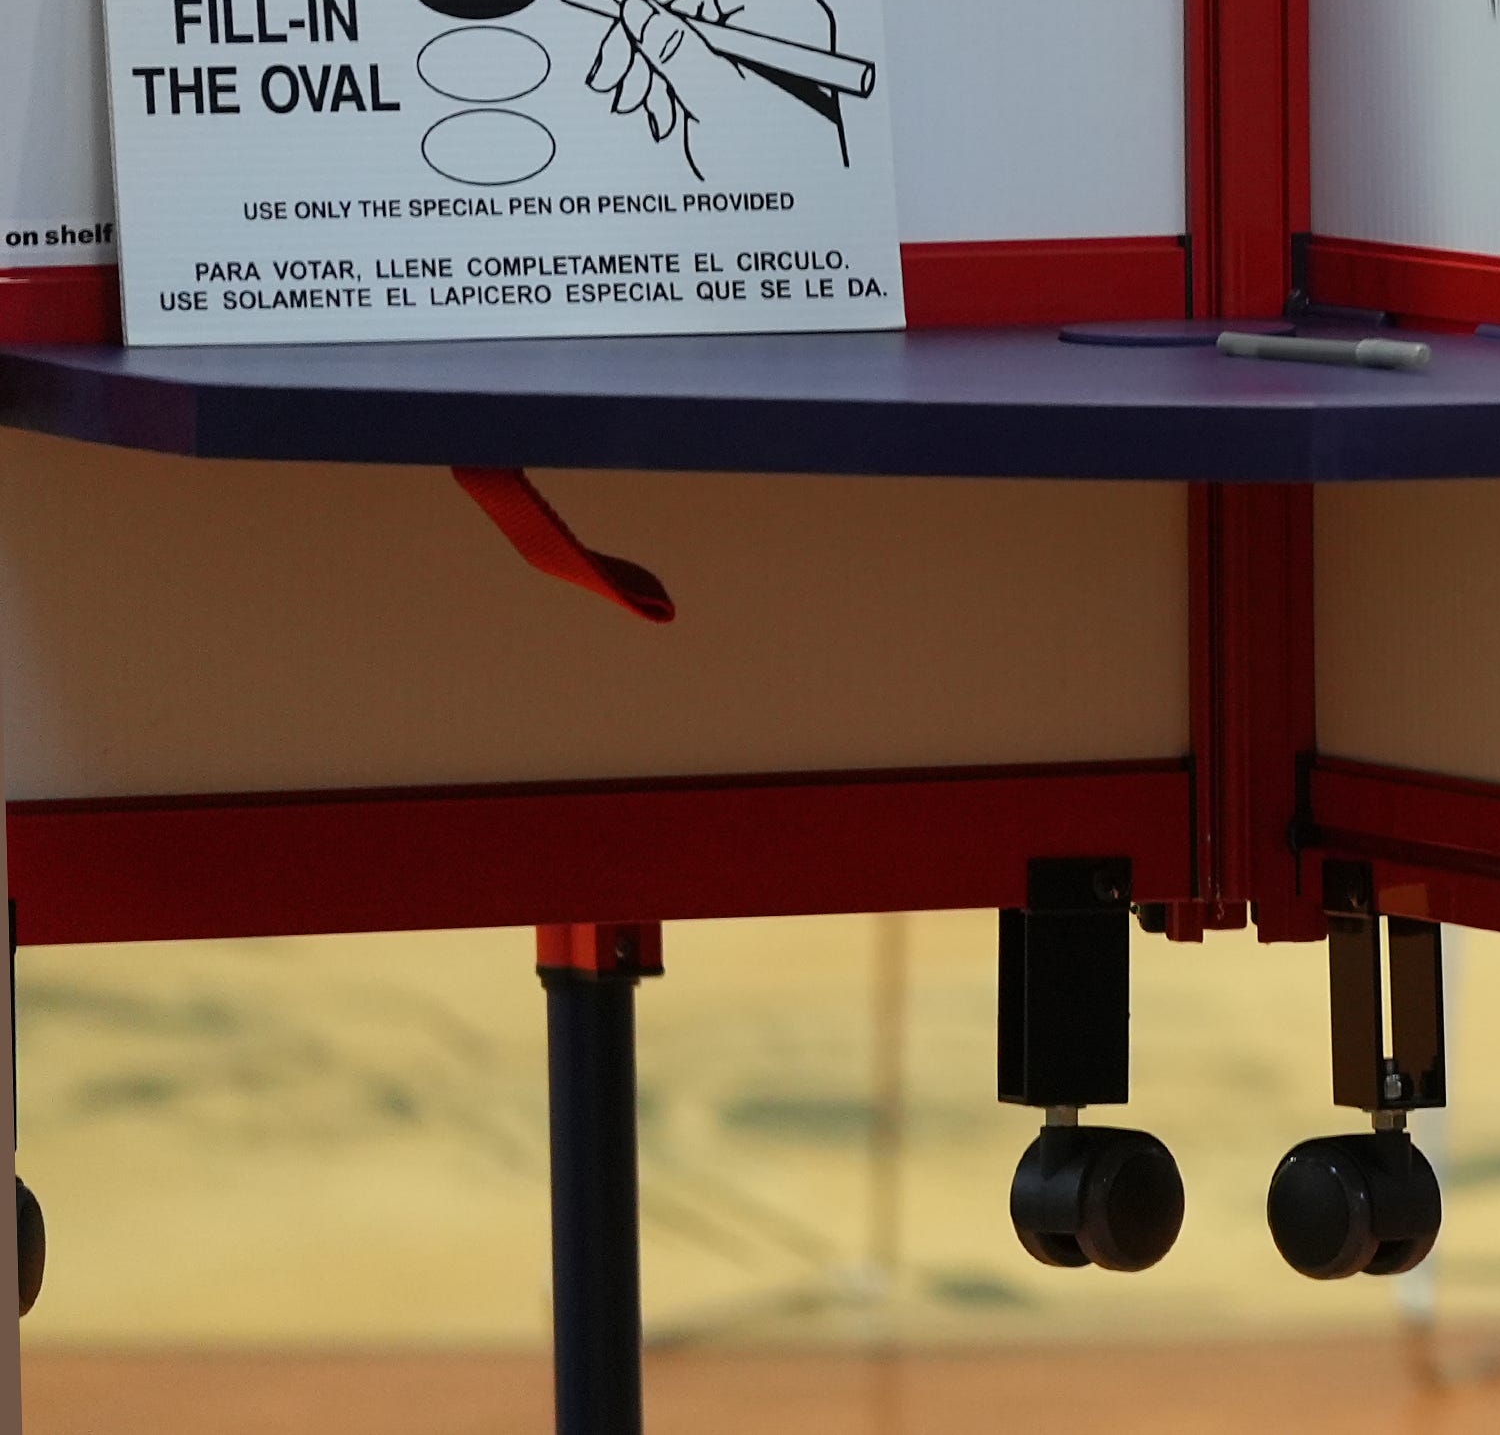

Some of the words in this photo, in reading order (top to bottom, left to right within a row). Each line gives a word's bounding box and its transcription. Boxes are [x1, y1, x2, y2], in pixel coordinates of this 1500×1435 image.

[131, 65, 241, 116] THE
[260, 63, 401, 115] OVAL
[243, 201, 288, 221] USE
[294, 200, 352, 220] ONLY
[357, 199, 402, 218] THE
[408, 197, 503, 218] SPECIAL
[508, 196, 552, 216] PEN
[559, 195, 591, 215] OR
[597, 194, 678, 214] PENCIL
[682, 191, 795, 213] PROVIDED
[5, 230, 39, 247] on
[45, 222, 113, 245] shelf
[195, 261, 262, 283] PARA
[272, 259, 361, 283] VOTAR,
[375, 257, 453, 279] LLENE
[467, 253, 681, 278] COMPLETAMENTE
[694, 252, 724, 273] EL
[736, 250, 850, 272] CIRCULO.
[159, 290, 209, 312] USE
[222, 288, 372, 311] SOLAMENTE
[386, 287, 417, 307] EL
[430, 284, 552, 306] LAPICERO
[566, 281, 684, 303] ESPECIAL
[696, 280, 747, 302] QUE
[760, 278, 792, 300] SE
[805, 278, 835, 299] LE
[847, 277, 888, 298] DA.
